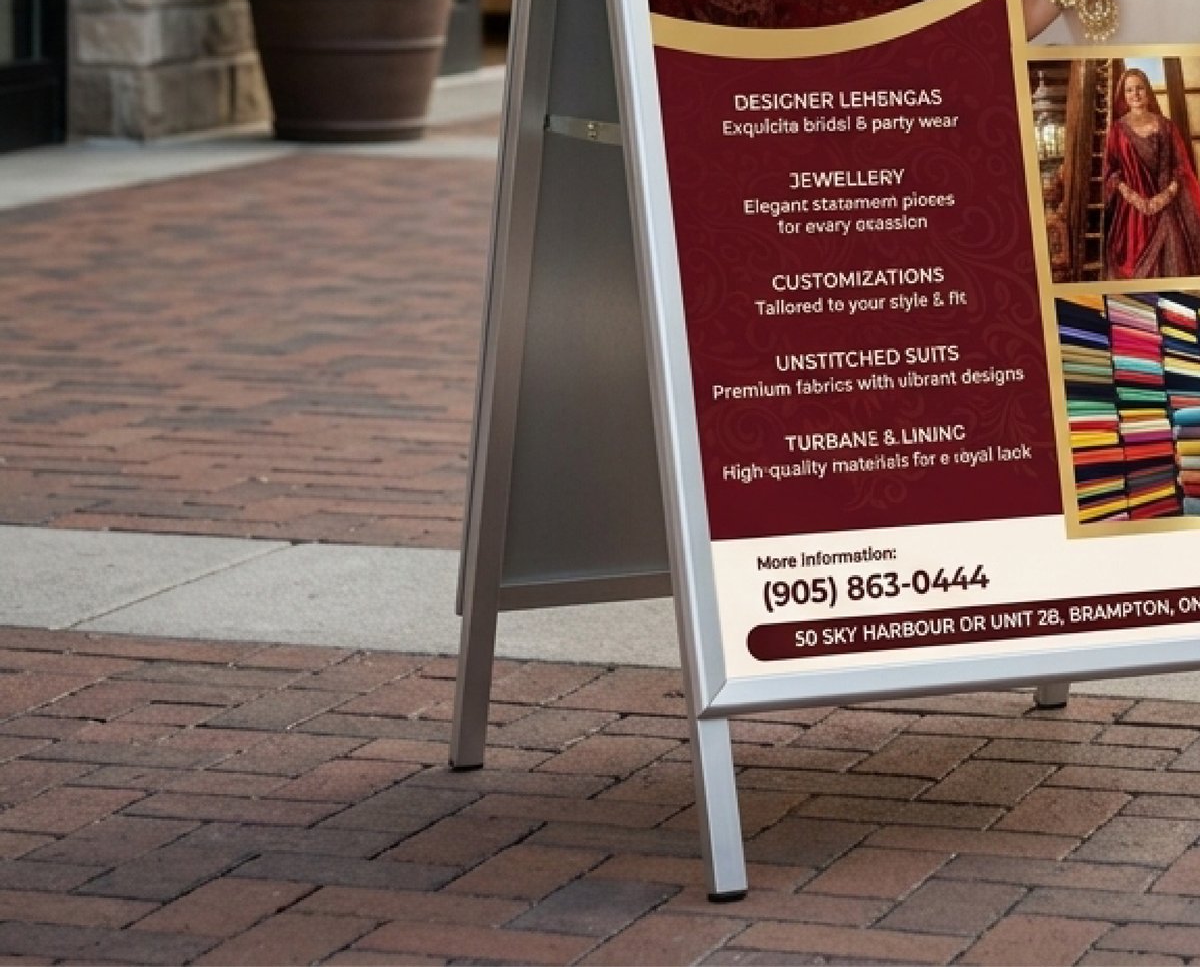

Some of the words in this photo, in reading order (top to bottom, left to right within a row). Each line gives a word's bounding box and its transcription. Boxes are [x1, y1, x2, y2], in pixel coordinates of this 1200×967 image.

[733, 91, 835, 112] DESIGNER
[872, 114, 914, 134] party
[918, 114, 959, 129] wear
[788, 168, 906, 190] JEWELLERY
[743, 197, 809, 218] Elegant
[771, 266, 945, 292] CUSTOMIZATIONS
[827, 296, 844, 313] to
[848, 296, 886, 316] your
[932, 290, 945, 308] &
[776, 348, 900, 371] UNSTITCHED
[905, 344, 959, 364] SUITS
[712, 379, 791, 401] Premium
[855, 372, 896, 391] with
[961, 365, 1026, 387] designs
[784, 432, 880, 452] TURBANE
[912, 450, 936, 468] for
[757, 555, 797, 571] More
[801, 545, 897, 569] Information:
[763, 575, 838, 613] (905)
[847, 564, 990, 601] 863-0444
[822, 627, 857, 645] SKY
[862, 617, 955, 642] HARBOUR
[991, 610, 1033, 630] UNIT
[1069, 599, 1176, 623] BRAMPTON,
